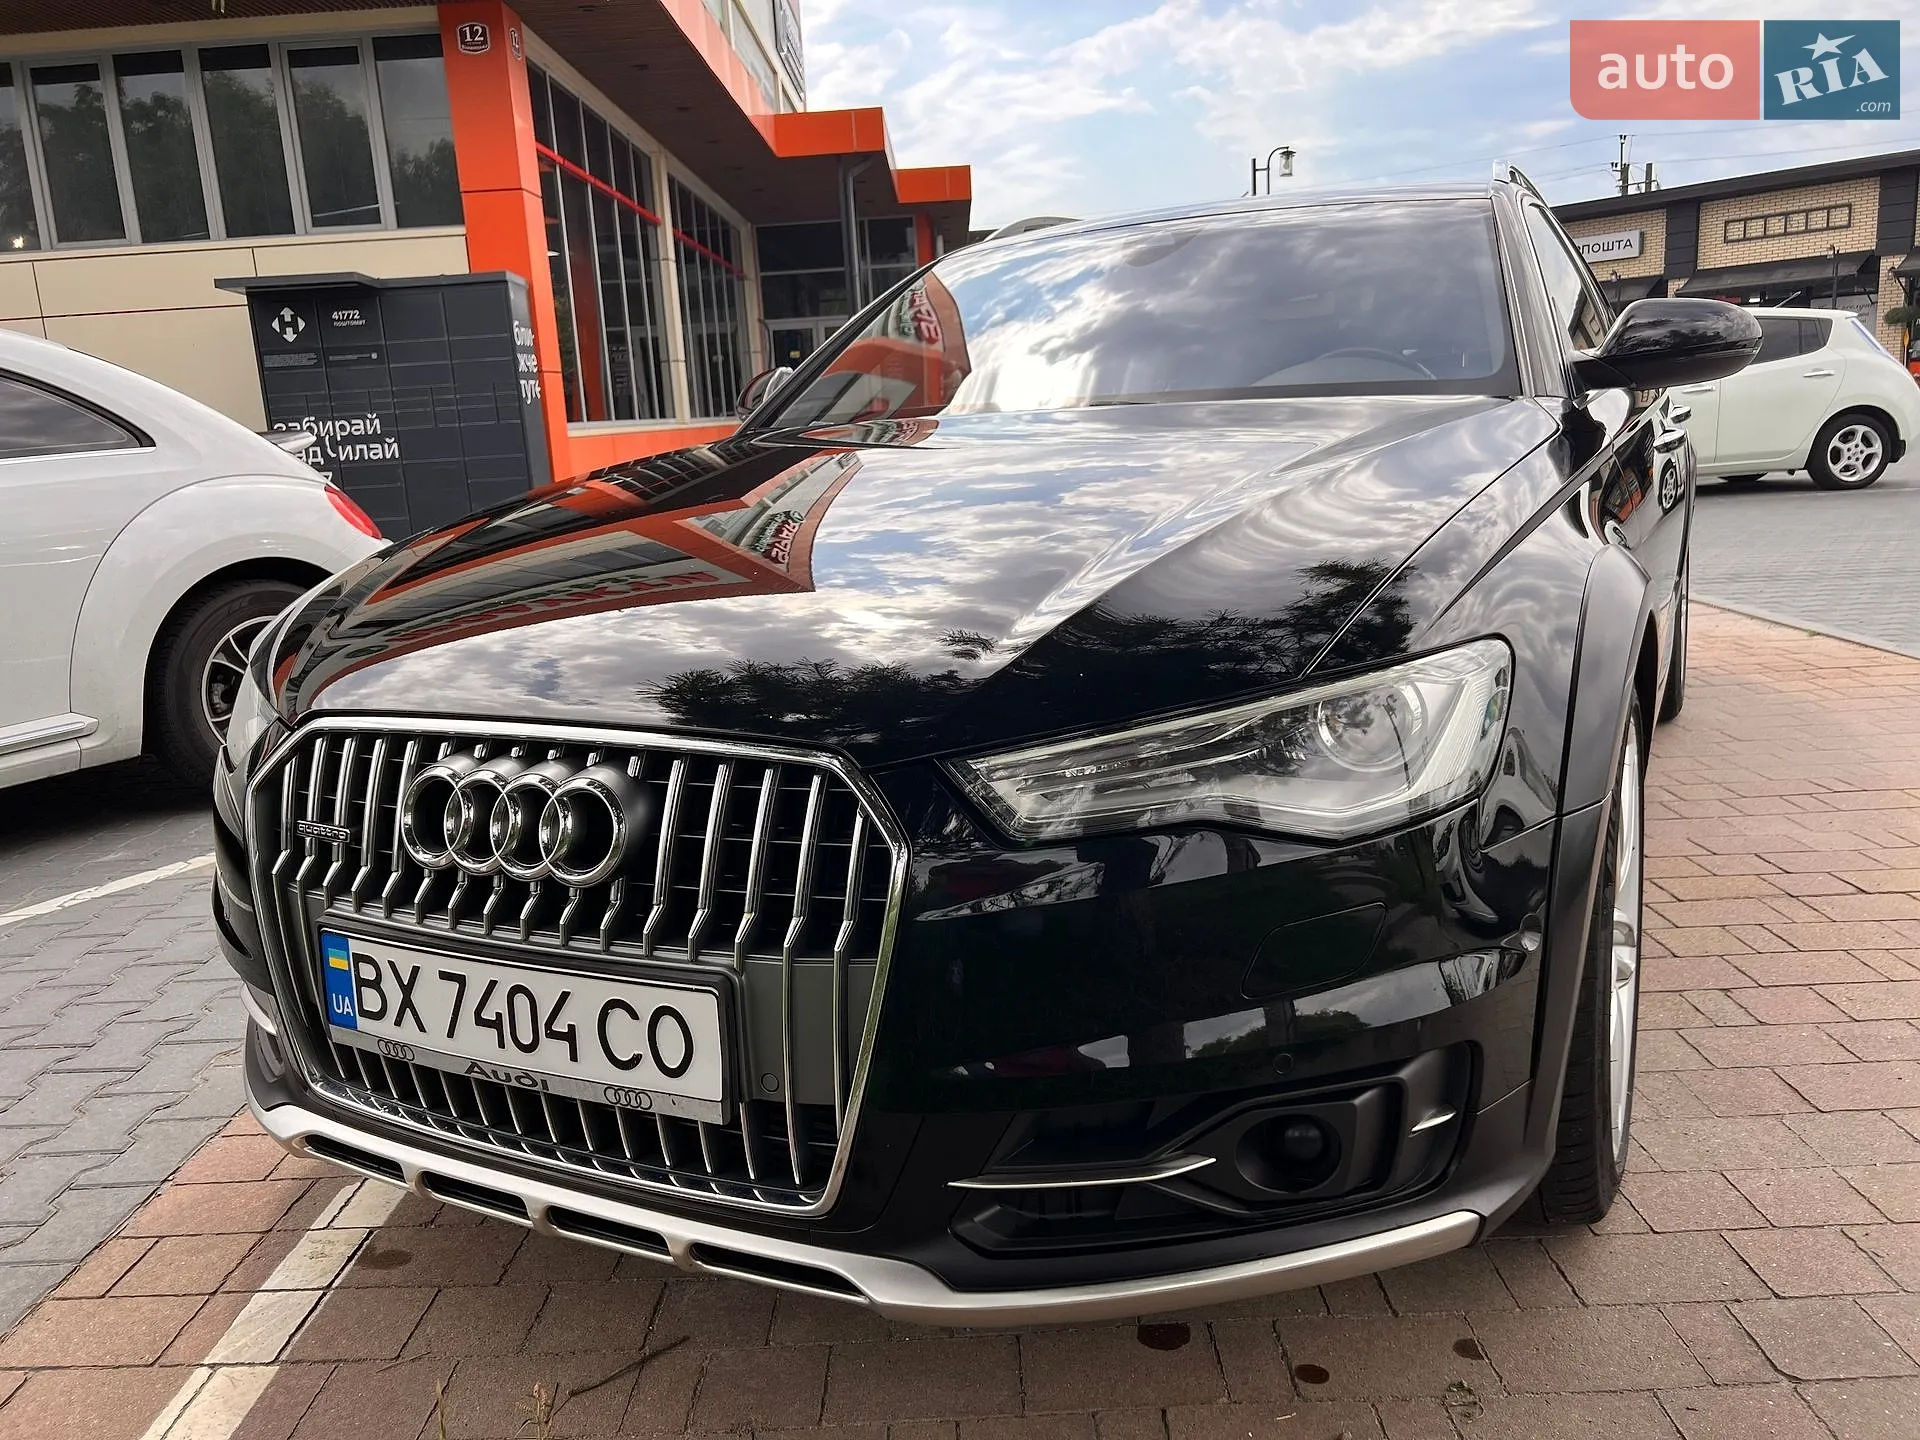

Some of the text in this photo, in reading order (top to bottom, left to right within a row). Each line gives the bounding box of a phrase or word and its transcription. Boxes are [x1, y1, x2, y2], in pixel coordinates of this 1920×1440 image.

[462, 25, 484, 42] 12
[331, 309, 361, 320] 41772
[298, 824, 346, 840] quattro
[332, 992, 354, 1017] UA
[351, 952, 695, 1078] BX 7404 CO
[464, 1060, 549, 1091] Audi
